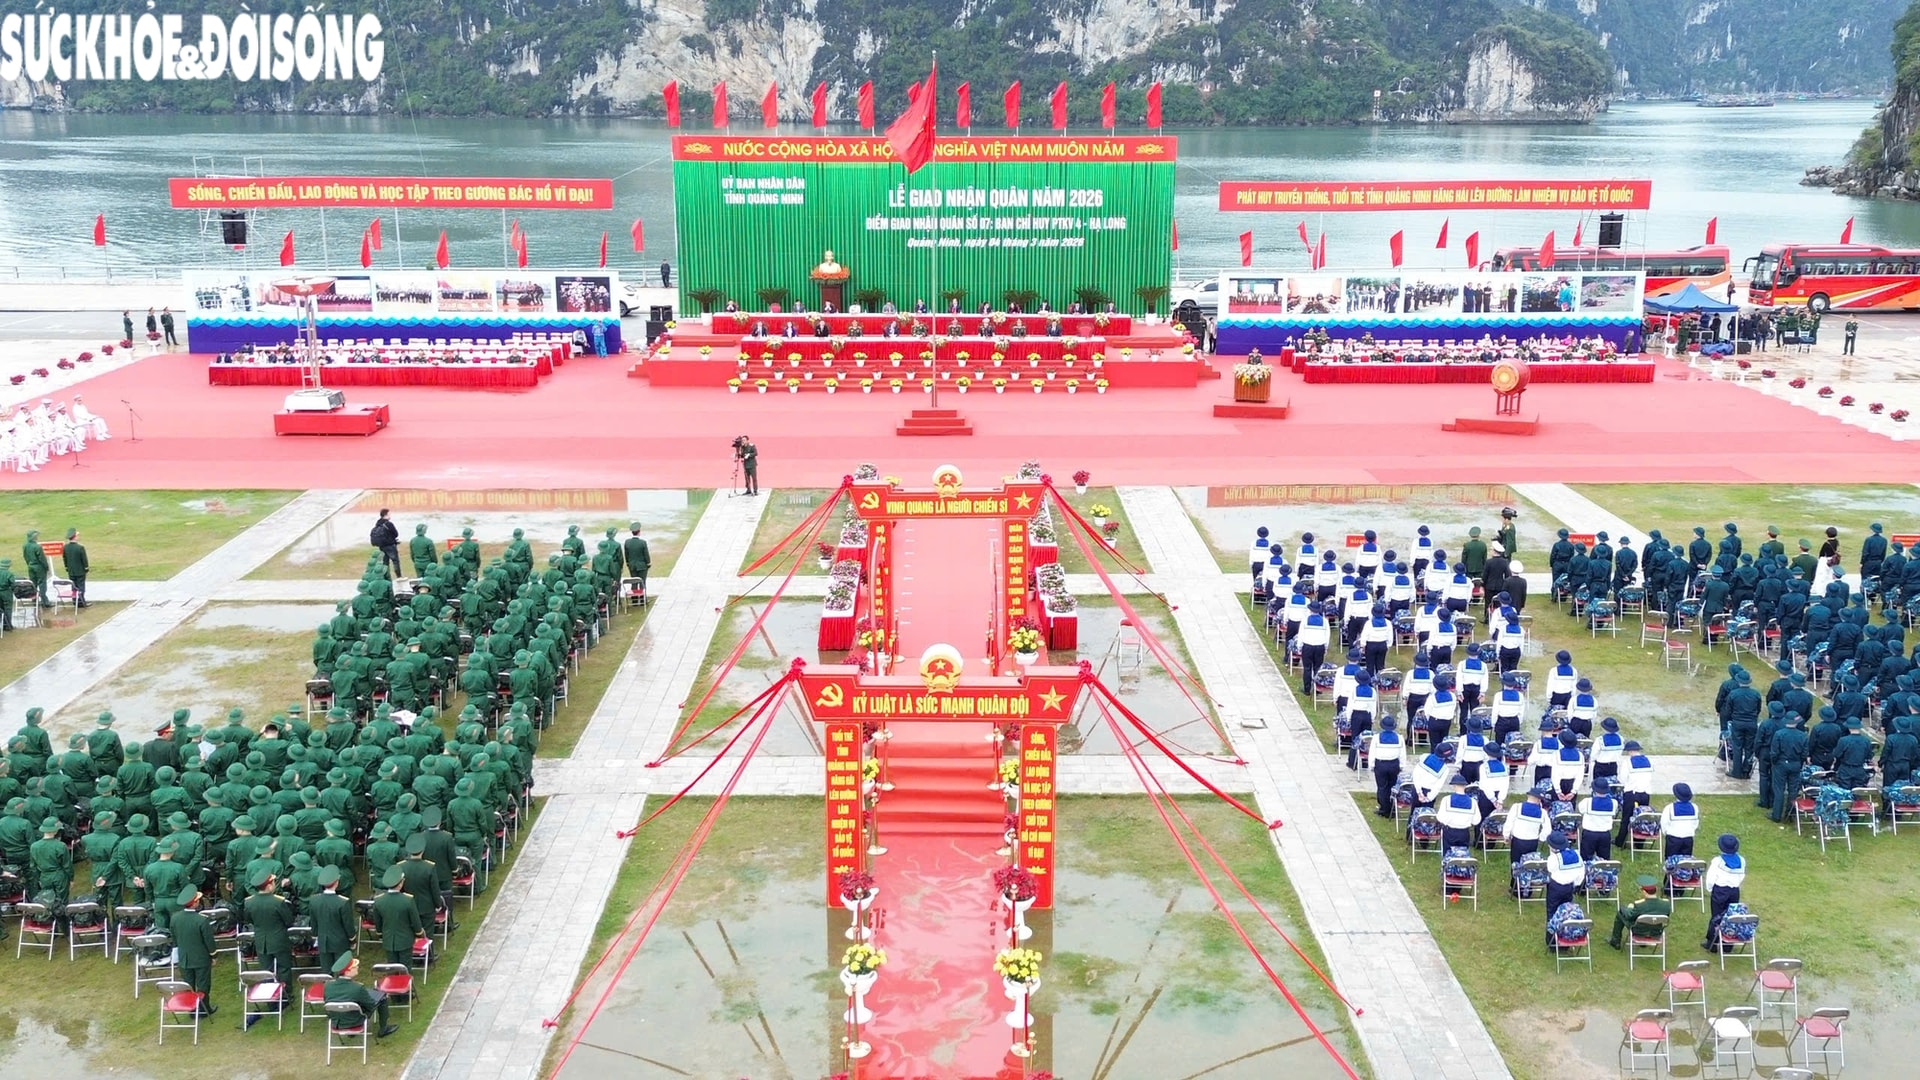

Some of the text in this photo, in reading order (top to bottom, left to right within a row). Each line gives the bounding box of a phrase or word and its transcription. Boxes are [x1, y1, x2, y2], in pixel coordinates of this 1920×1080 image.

[724, 140, 1124, 159] NƯỚC CỘNG HÒA XÃ HỘ NGHĨA VIỆT NAM MUÔN NĂM
[736, 178, 756, 189] BAN
[757, 176, 784, 189] NHÂN
[786, 176, 805, 189] DÂN
[188, 182, 593, 204] SỐNG, CHIẾN ĐẤU, LAO ĐỘNG VÀ HỌC TẬP THEO GƯƠNG BÁC HỒ VĨ ĐẠI!
[889, 183, 1103, 210] LỄ GIAO NHẬN QUÂN NĂM 2026
[1237, 184, 1634, 206] PHÁT HUY TRUYỀN THỐNG, TUỔI TRẺ TỈNH QUẢNG NINH HĂNG HÁI LÊN ĐƯỜNG LÀM NHIỆM VỤ BẢO VỆ TỔ QUỐC!
[866, 213, 888, 230] ĐIỂM
[891, 218, 911, 230] GIAO
[913, 215, 938, 232] NHẬN
[940, 215, 964, 231] QUÂN
[966, 213, 978, 230] SỐ
[980, 218, 993, 230] 07:
[995, 217, 1014, 230] BAN
[1016, 214, 1031, 230] CHỈ
[1033, 217, 1050, 230] HUY
[1052, 217, 1074, 230] PTKV
[1076, 217, 1081, 230] 4
[1090, 217, 1101, 232] HẠ
[1103, 217, 1126, 230] LONG
[886, 501, 905, 514] VINH
[907, 501, 934, 515] QUANG
[935, 499, 945, 514] LÀ
[947, 498, 972, 513] NGƯỜI
[973, 497, 998, 513] CHIẾN
[853, 691, 1029, 718] KỶ LUẬT LÀ SỨC MẠNH QUÂN ĐỘI
